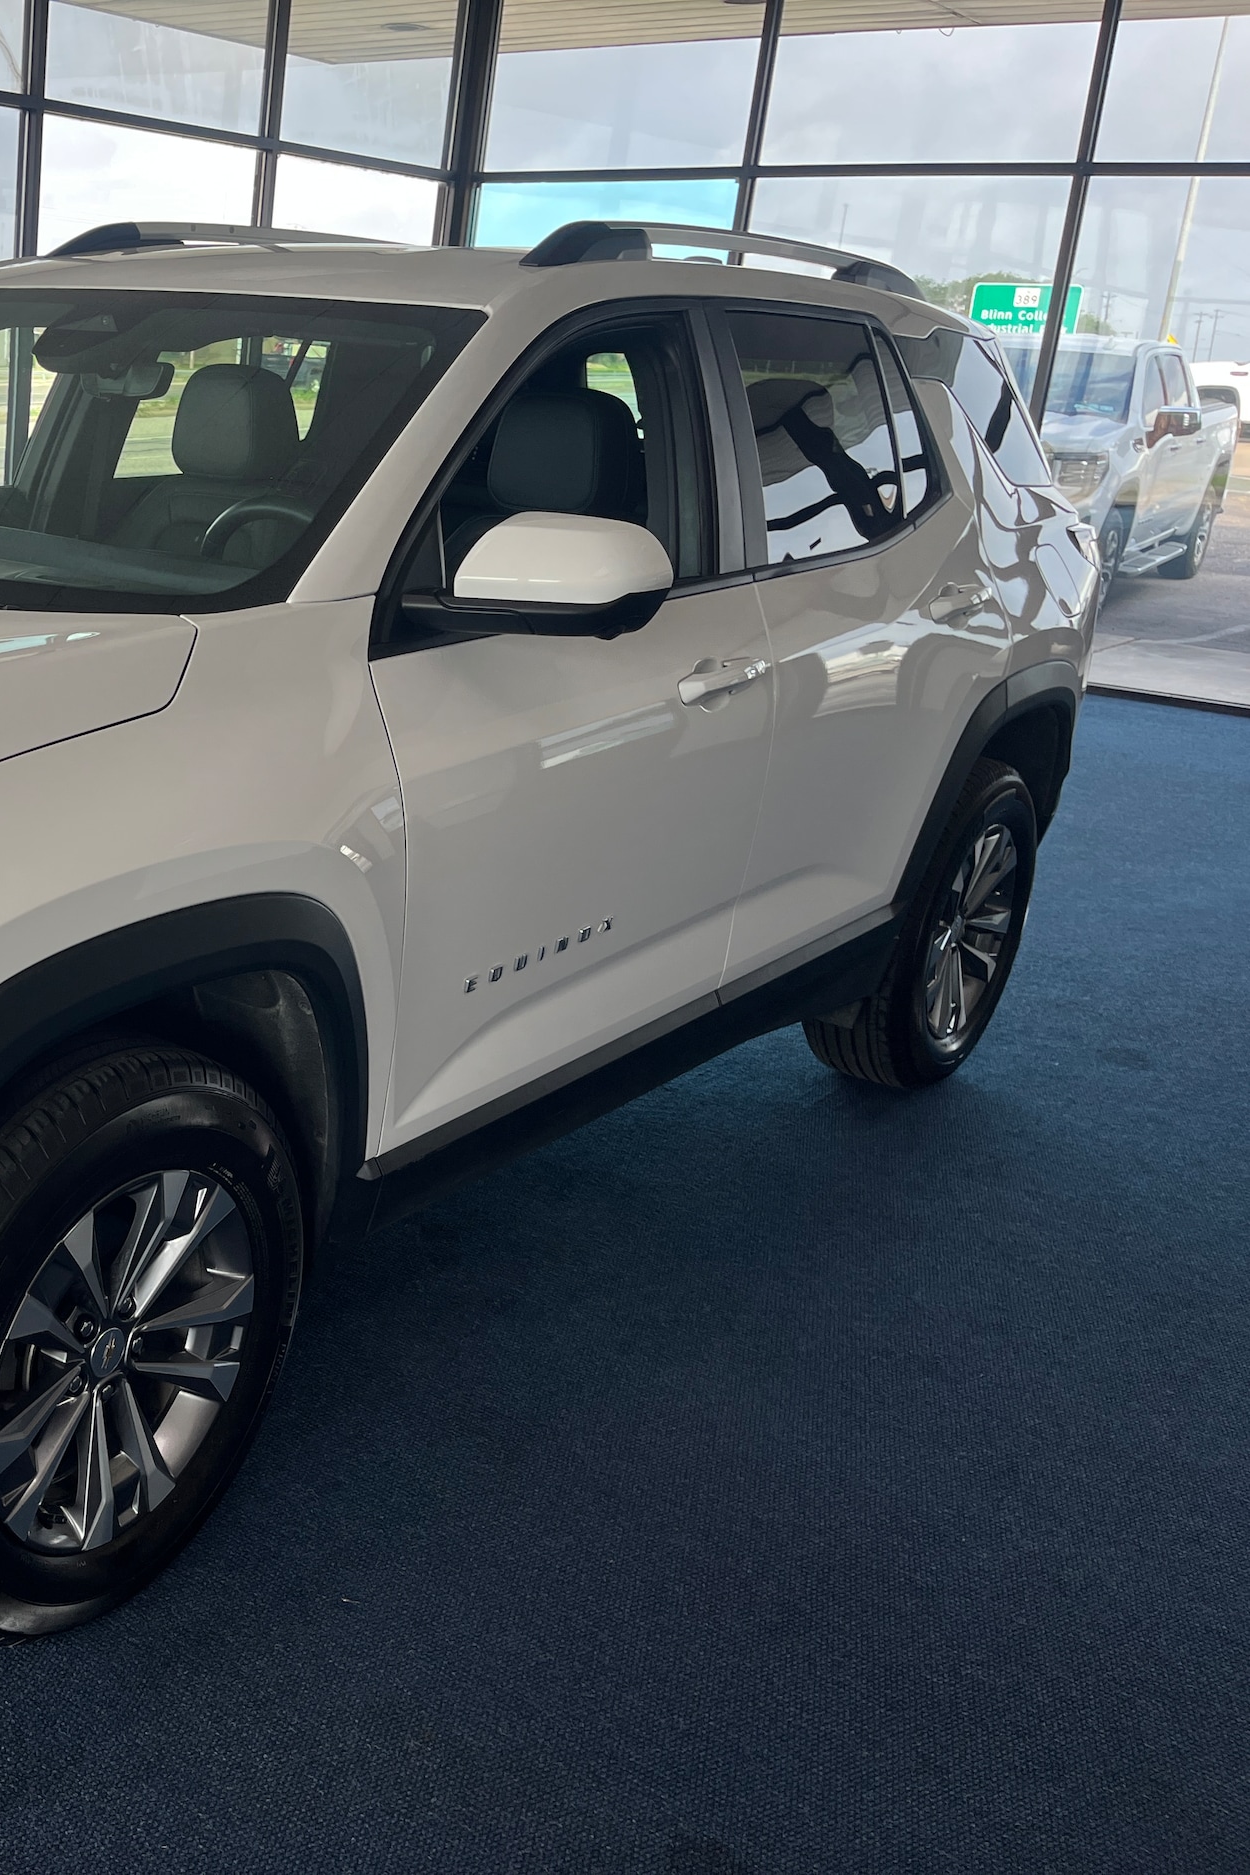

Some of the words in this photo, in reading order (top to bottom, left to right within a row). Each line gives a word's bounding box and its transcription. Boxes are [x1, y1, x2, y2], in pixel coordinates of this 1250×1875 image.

[1015, 295, 1038, 305] 389
[981, 309, 1013, 320] Blinn
[463, 914, 614, 994] EQUINOX
